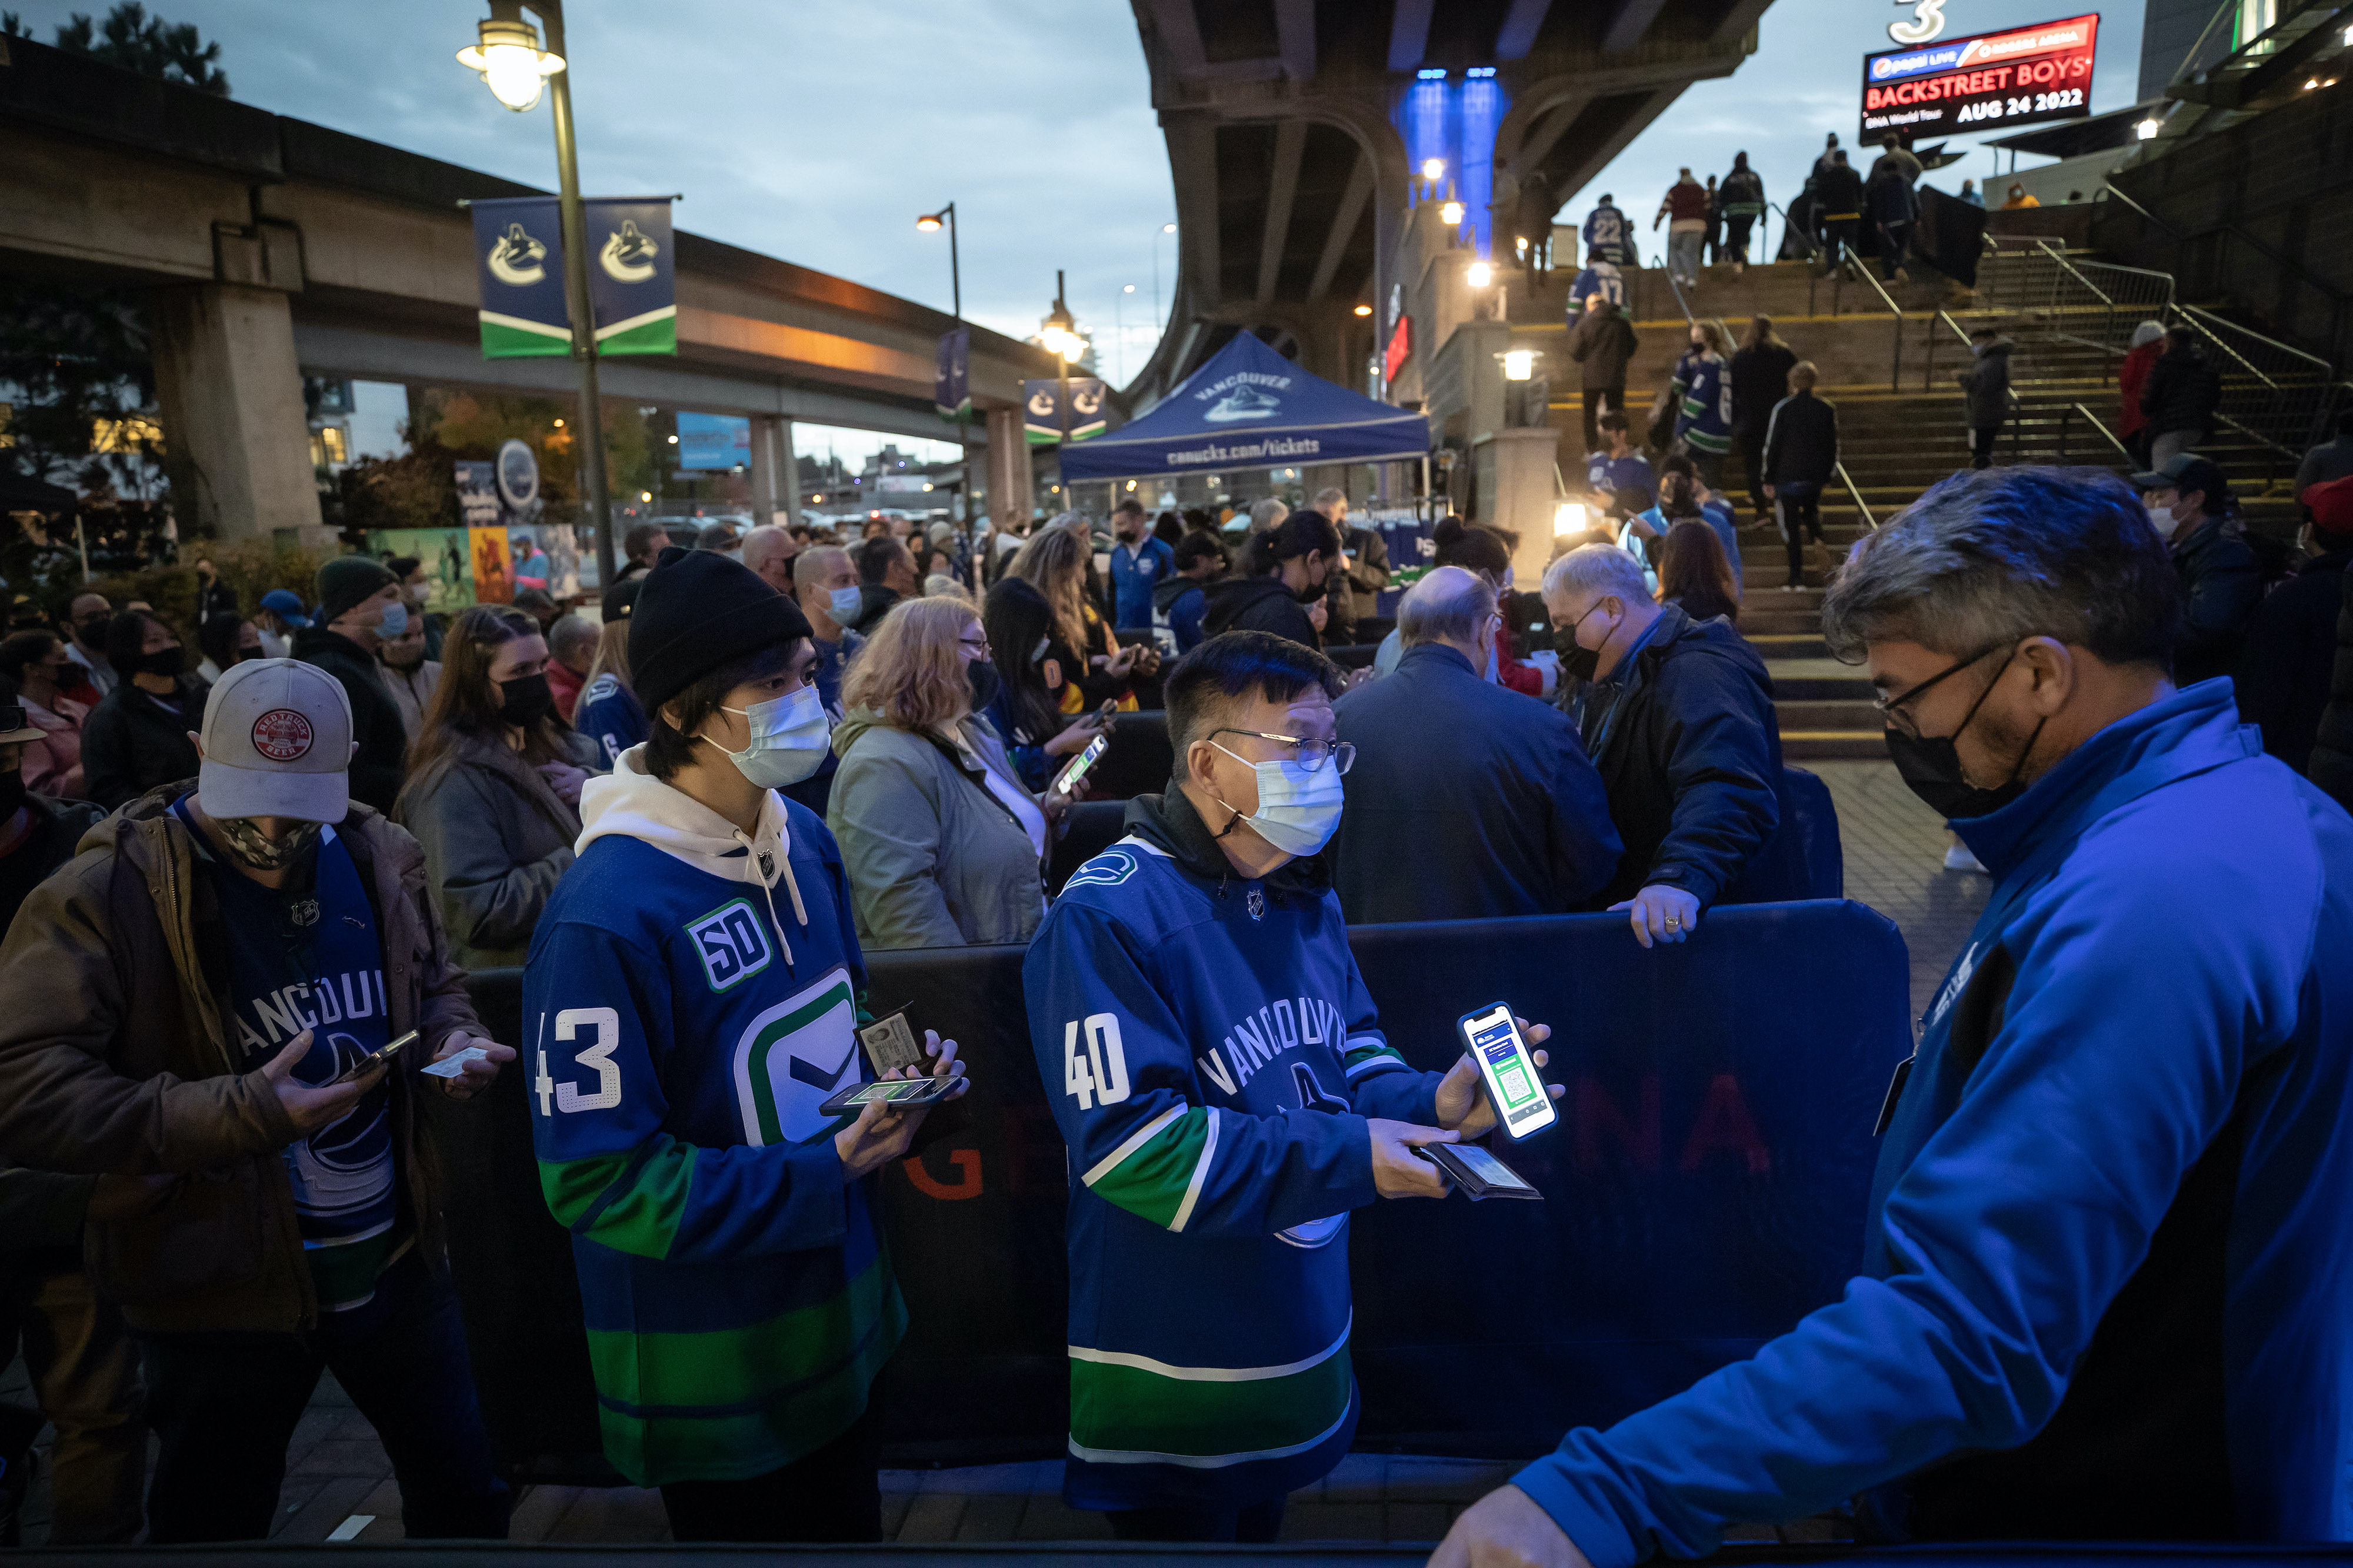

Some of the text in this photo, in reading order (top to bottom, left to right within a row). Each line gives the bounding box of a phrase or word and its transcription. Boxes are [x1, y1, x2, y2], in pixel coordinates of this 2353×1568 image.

[1929, 51, 1958, 66] LIVE
[1867, 56, 2085, 110] BACKSTREET BOYS
[1957, 88, 2083, 124] AUG 24 2022
[1194, 372, 1291, 401] VANCOUVER
[1166, 436, 1320, 465] canucks.com/tickets
[259, 713, 308, 735] RED TRUCK
[266, 745, 295, 756] BEER
[703, 908, 765, 978] 50
[1065, 1012, 1131, 1110] 40
[1197, 997, 1347, 1096] VANCOUVE
